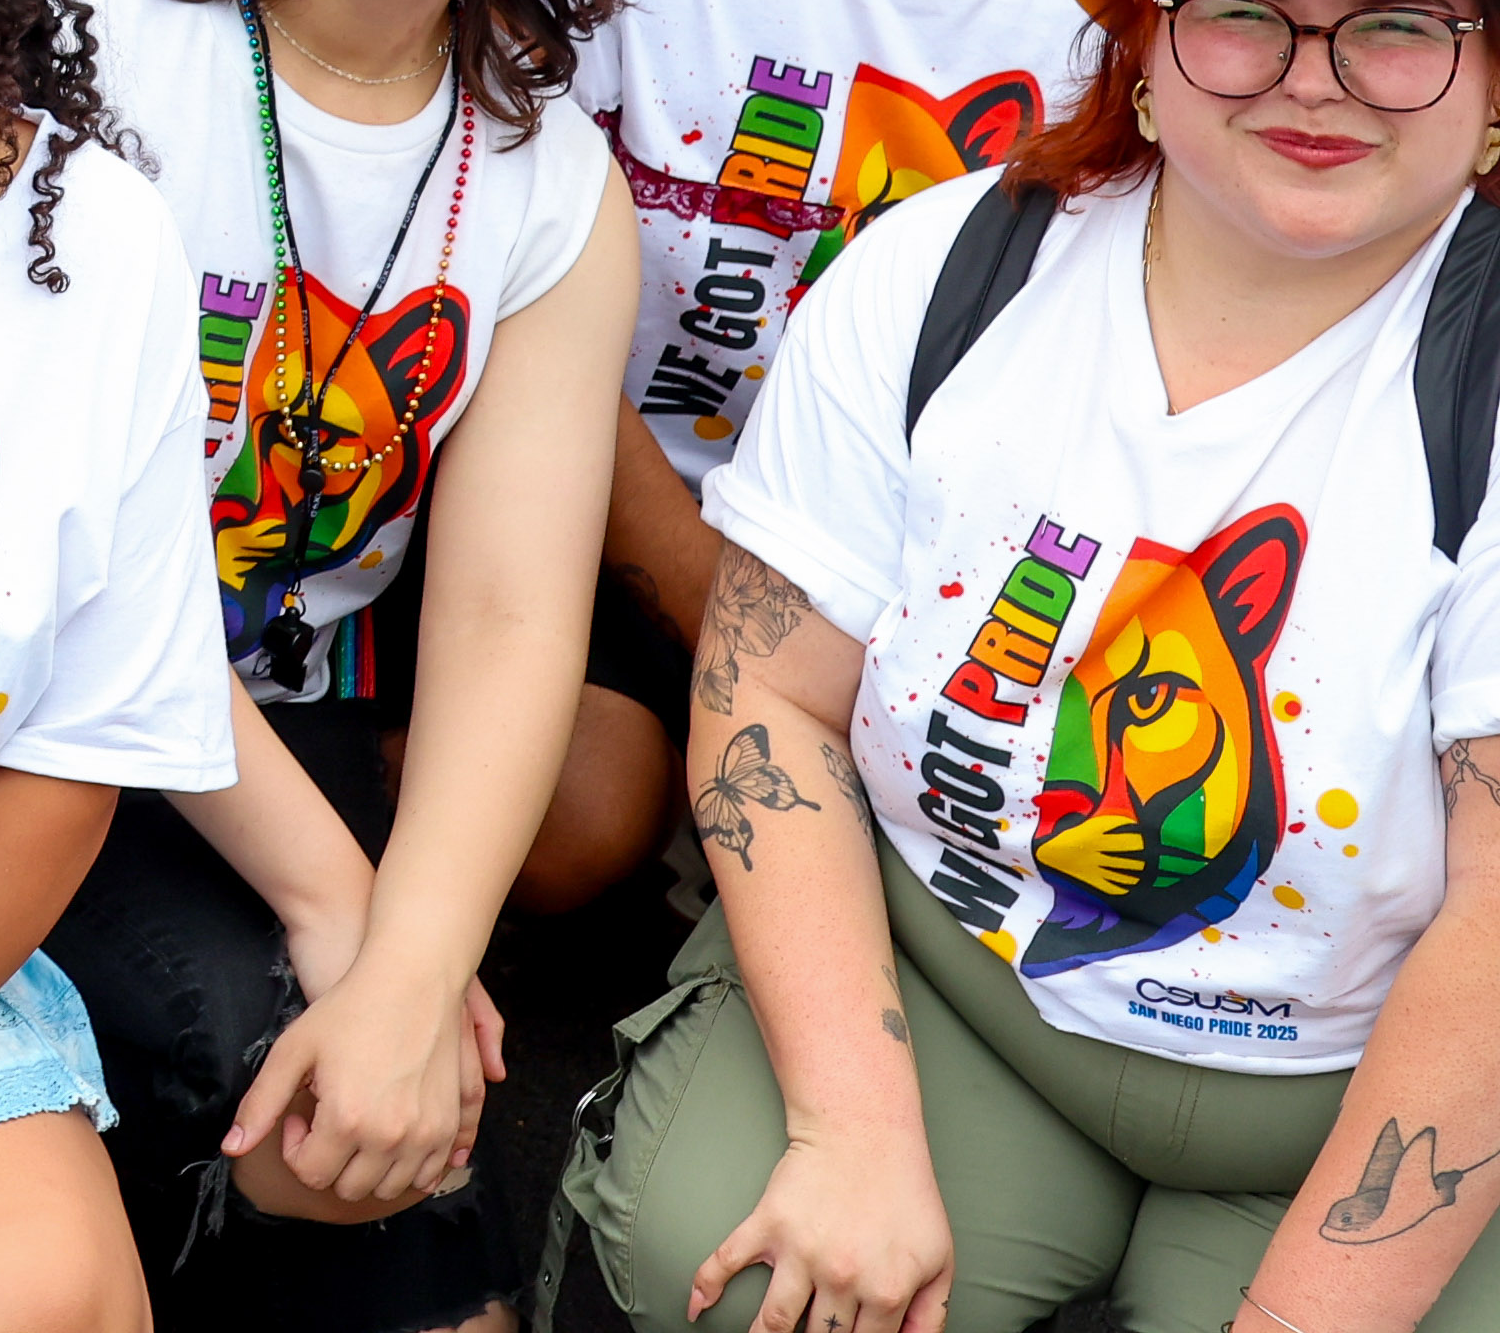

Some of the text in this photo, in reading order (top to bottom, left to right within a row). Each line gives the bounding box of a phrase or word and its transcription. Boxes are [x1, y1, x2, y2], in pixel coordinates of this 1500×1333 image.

[638, 238, 775, 420] WE GOT
[919, 513, 1102, 856] GOT PRIDE
[1128, 999, 1299, 1042] SAN DIEGO PRIDE 2025
[1136, 978, 1292, 1019] CSUSM
